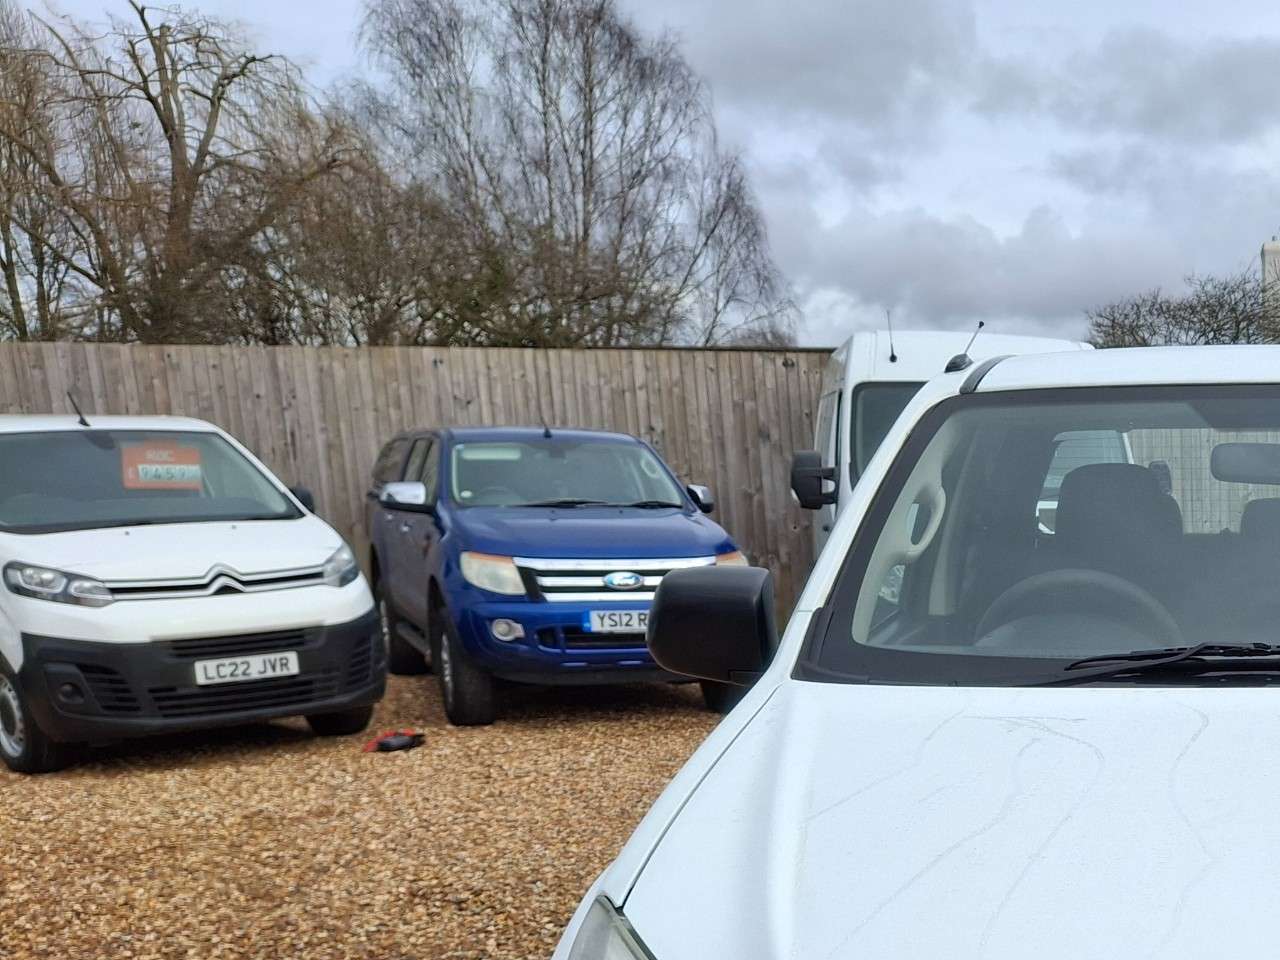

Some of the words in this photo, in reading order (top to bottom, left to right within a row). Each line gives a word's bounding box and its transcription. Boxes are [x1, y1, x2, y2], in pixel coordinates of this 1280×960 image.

[597, 613, 633, 627] YS12
[203, 661, 252, 680] LC22
[258, 656, 290, 675] JVR
